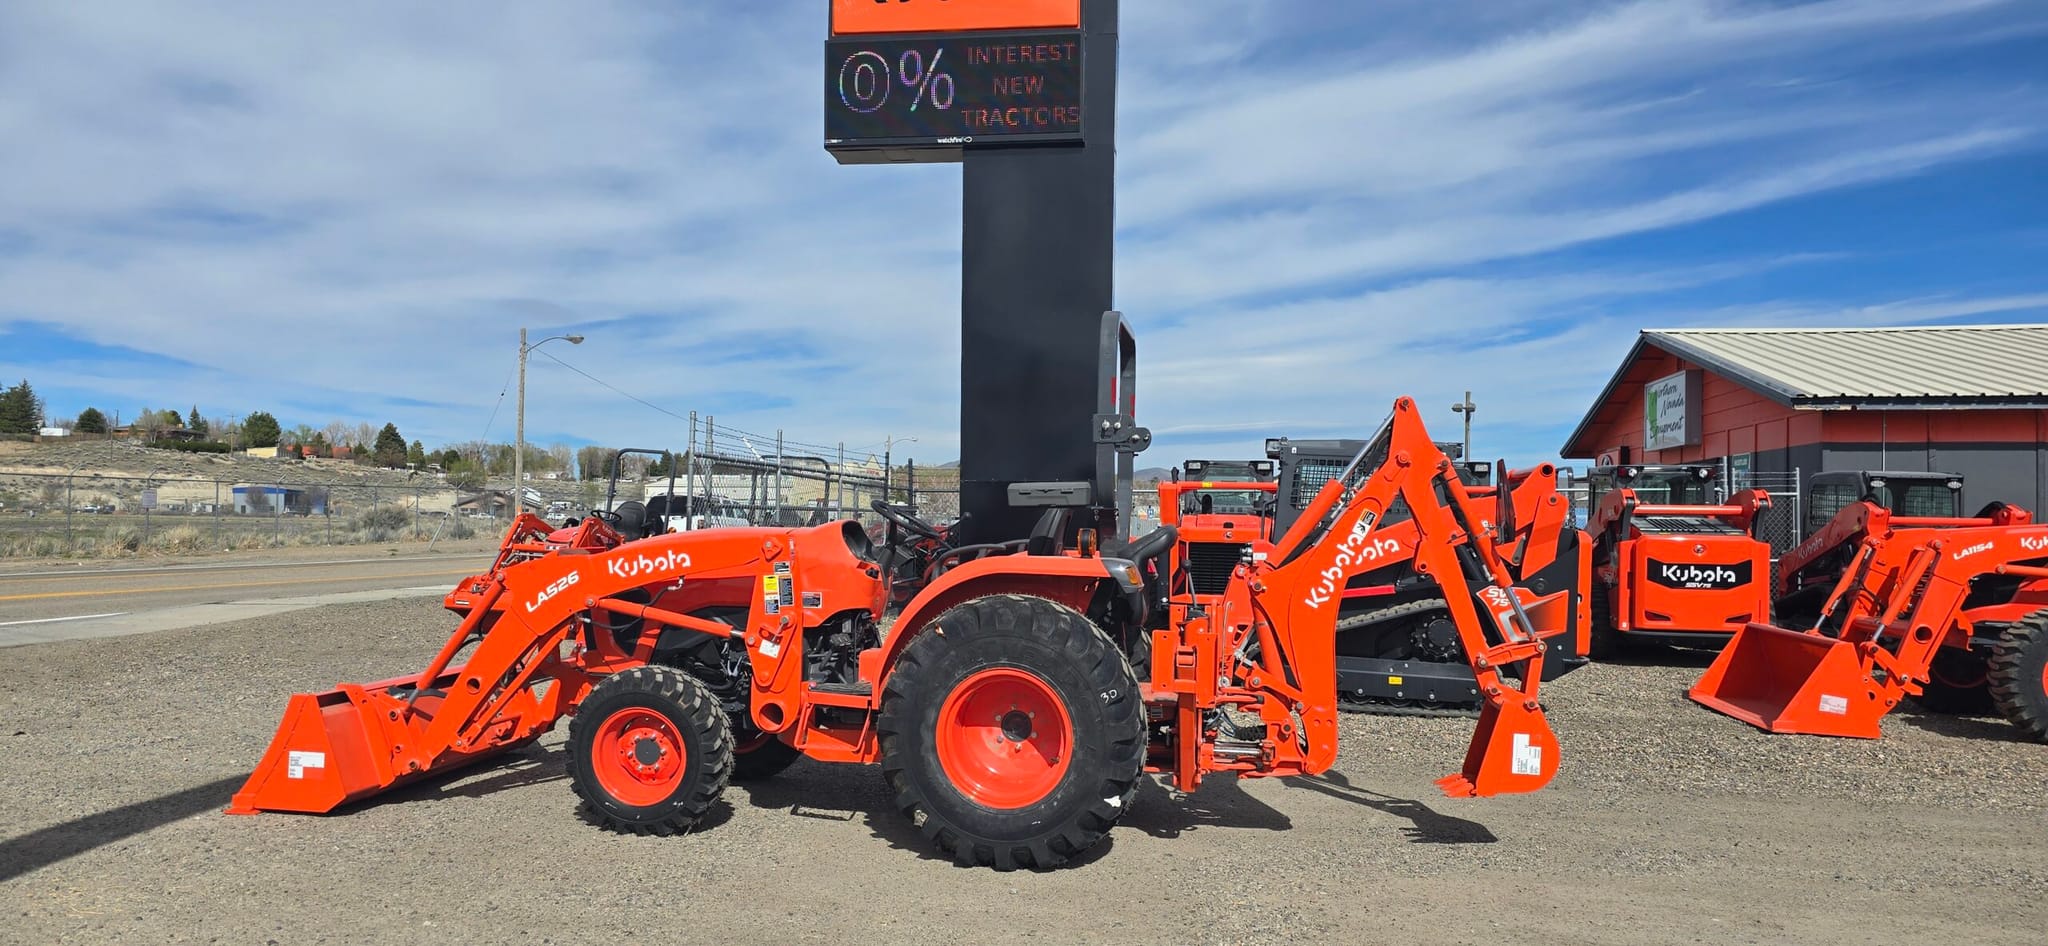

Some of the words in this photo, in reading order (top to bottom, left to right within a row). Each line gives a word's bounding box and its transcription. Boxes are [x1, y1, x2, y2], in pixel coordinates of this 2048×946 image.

[967, 43, 1076, 64] INTEREST
[993, 75, 1044, 96] NEW
[961, 106, 1080, 127] TRACTORS
[1953, 541, 1994, 560] LA1154
[608, 550, 691, 577] Kubota
[1304, 533, 1364, 609] Kubota
[1662, 565, 1736, 582] Kubota
[525, 570, 580, 613] LA526
